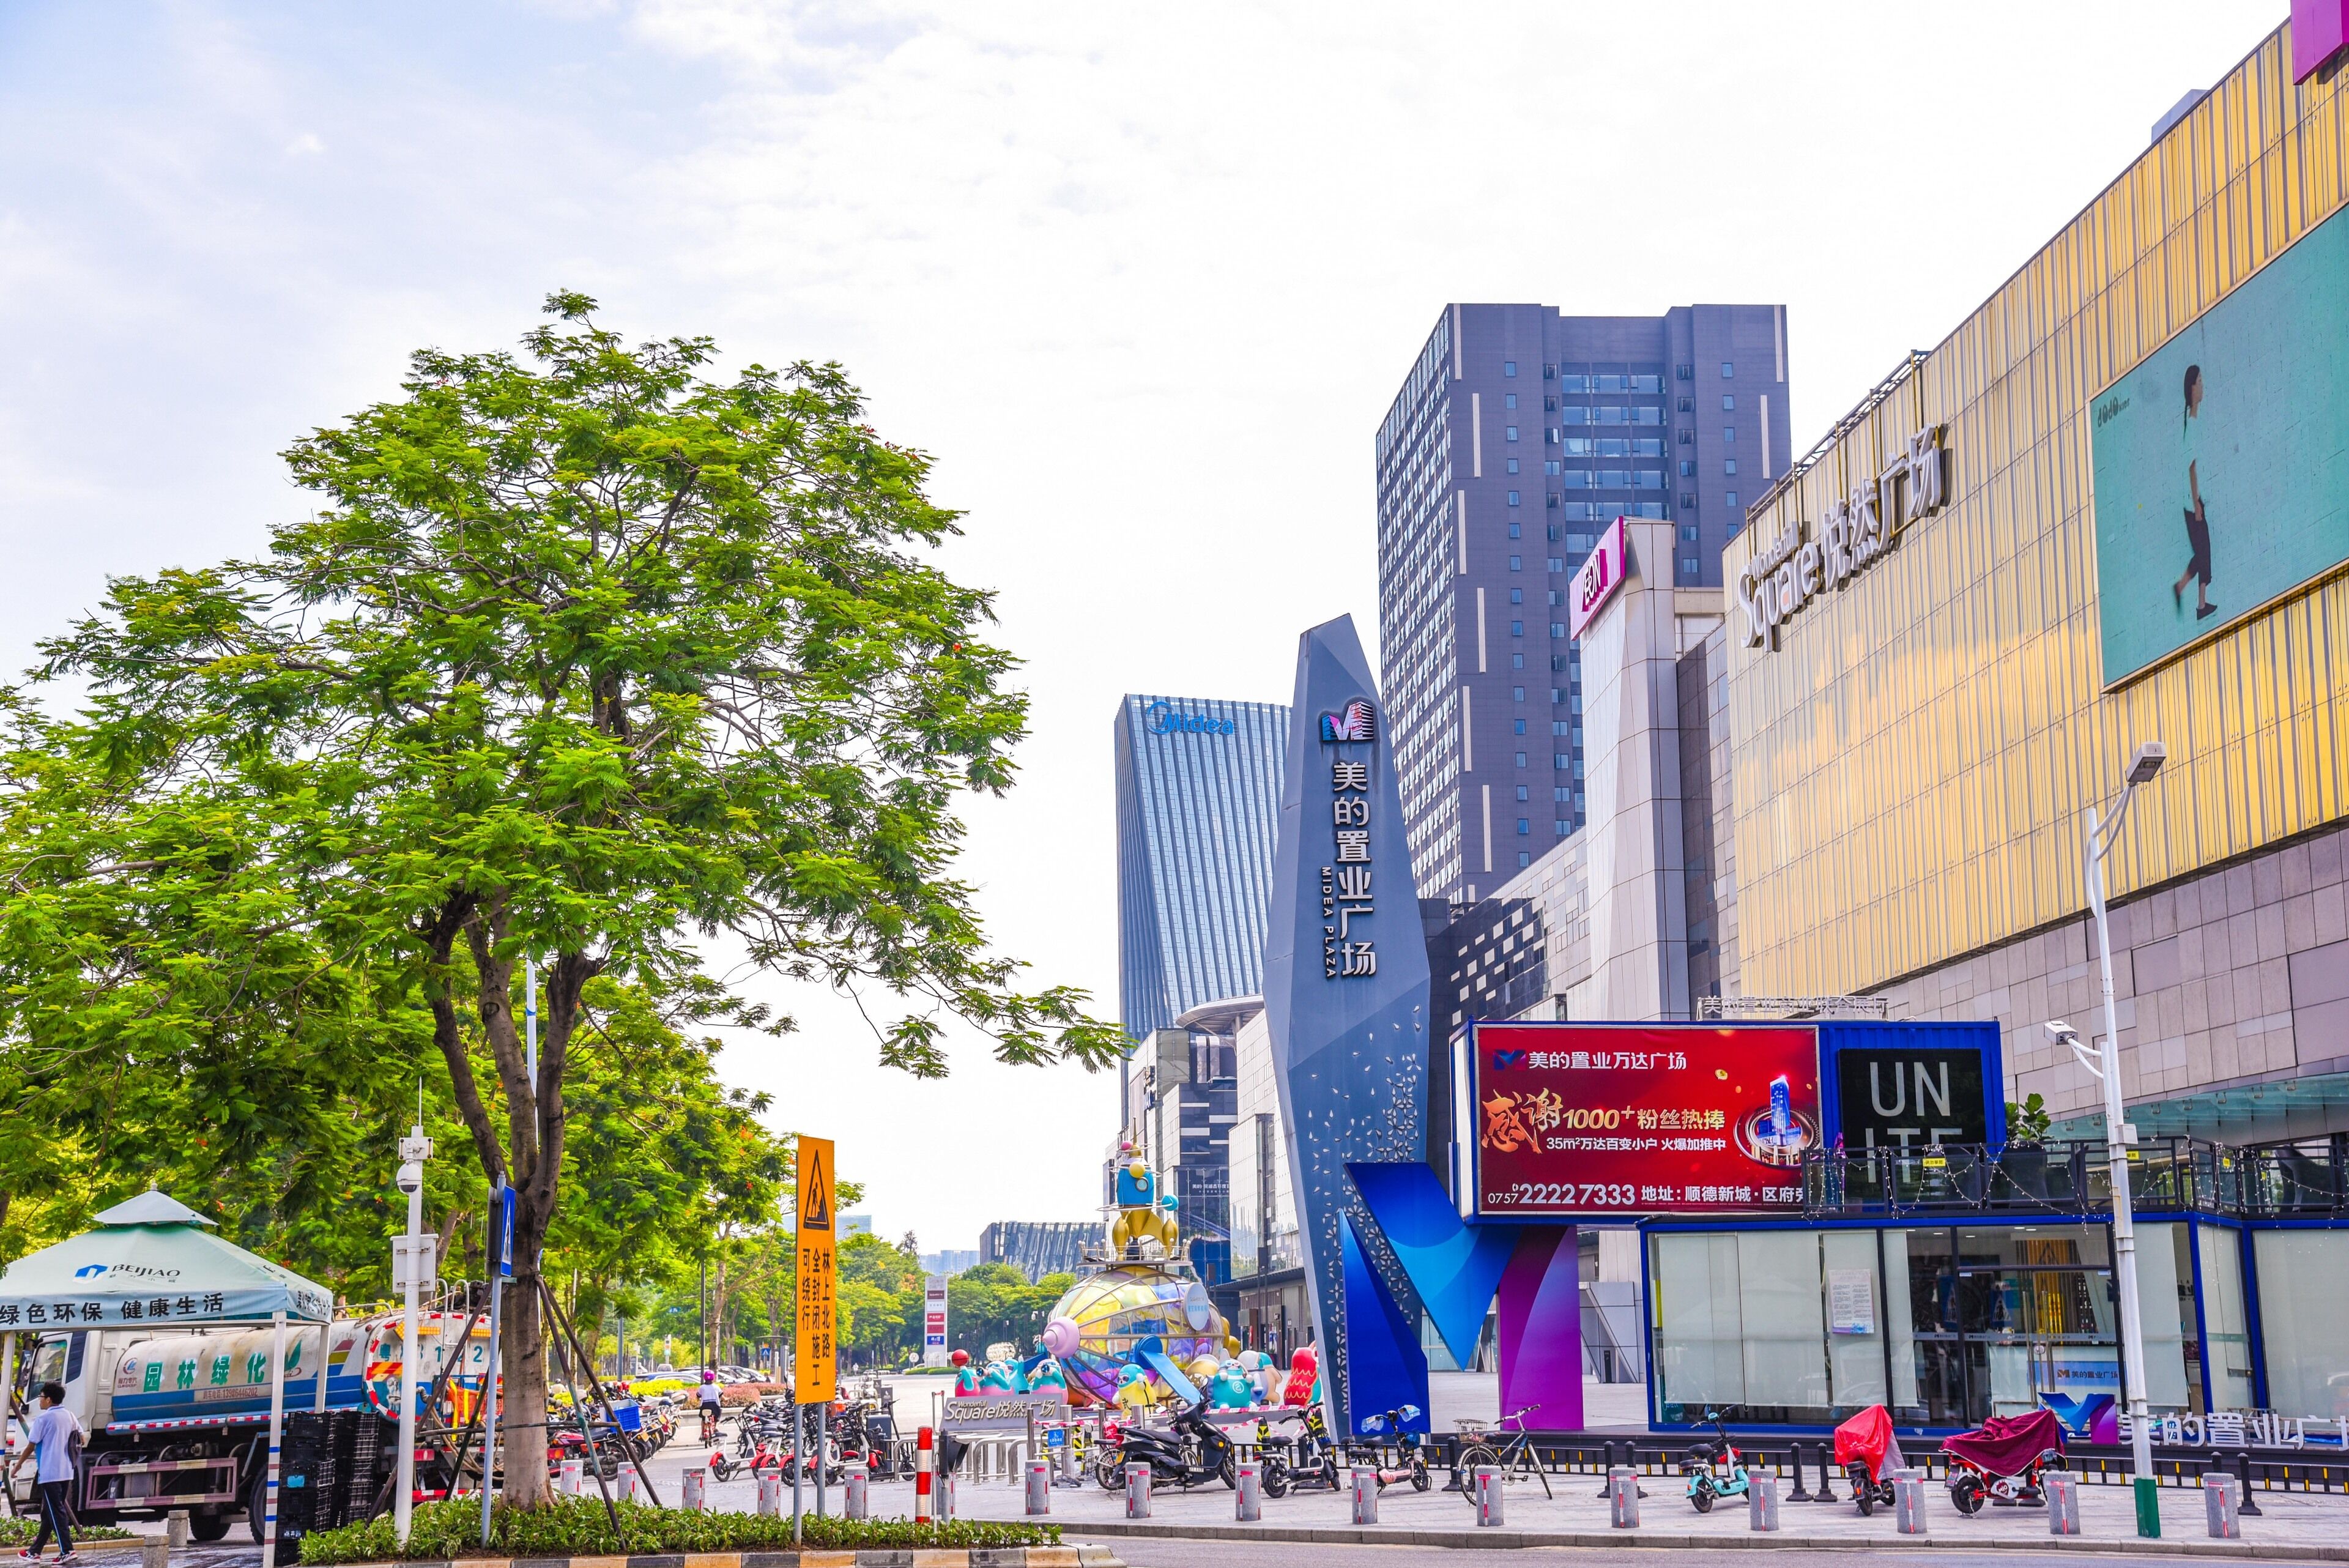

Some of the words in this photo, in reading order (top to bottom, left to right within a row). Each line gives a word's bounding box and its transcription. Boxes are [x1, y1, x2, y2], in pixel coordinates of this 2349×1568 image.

[1738, 542, 1819, 652] Square
[1821, 423, 1941, 592] 悦然广场
[1751, 522, 1800, 581] Wonderful
[1146, 700, 1234, 734] Midea
[1333, 761, 1376, 976] 美的置业广场
[1321, 866, 1334, 917] MIDEA
[1324, 925, 1337, 978] PLAZA
[1529, 1052, 1687, 1069] 美的置业万达广场
[1870, 1062, 1950, 1117] UN
[1661, 1138, 1726, 1151] 火爆加推中
[1488, 1193, 1518, 1204] 0757
[112, 1264, 180, 1276] BEIJIAO
[802, 1248, 811, 1331] 可绕行
[0, 1302, 103, 1325] 绿色环保
[121, 1292, 224, 1320] 健康生活
[143, 1351, 267, 1392] 园林绿化
[944, 1401, 996, 1424] Square
